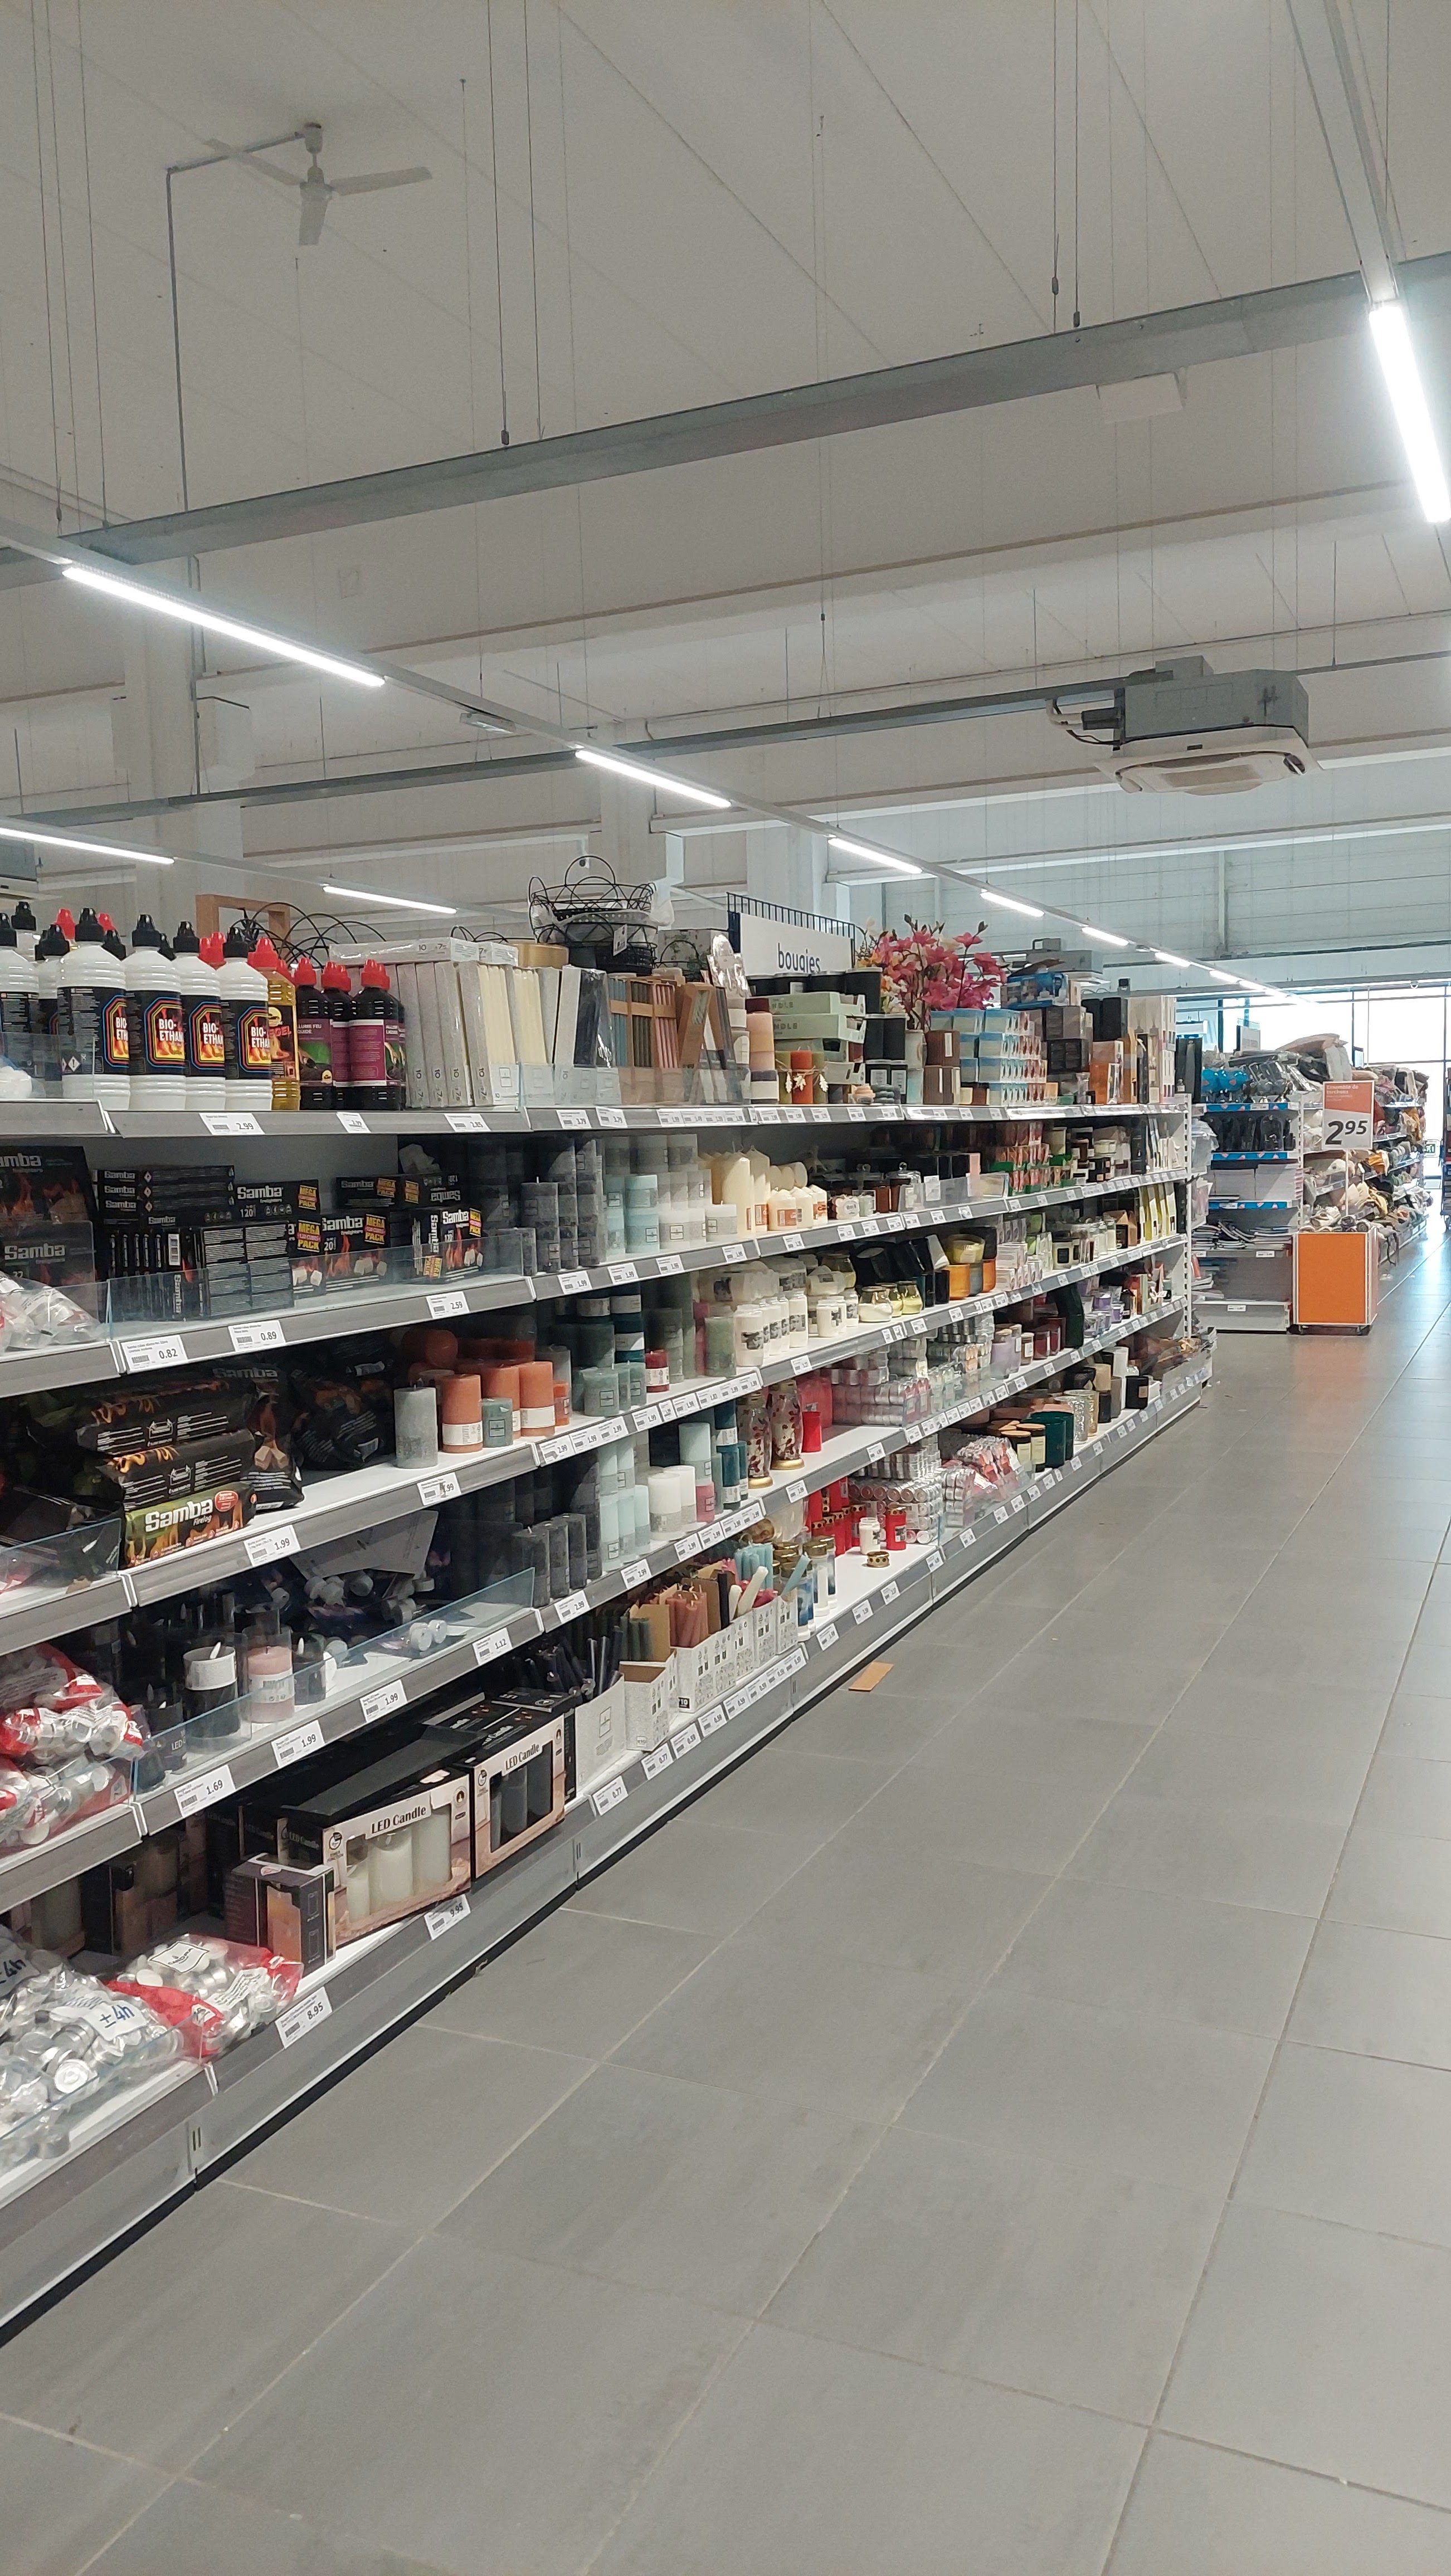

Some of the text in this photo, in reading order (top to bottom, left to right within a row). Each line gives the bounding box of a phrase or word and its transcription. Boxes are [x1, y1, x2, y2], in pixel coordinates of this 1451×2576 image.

[778, 943, 821, 973] bougies
[159, 1018, 177, 1030] BIO-
[203, 1023, 219, 1034] BIO-
[251, 1027, 266, 1037] BIO-
[105, 1171, 135, 1179] Samba
[104, 1185, 135, 1194] Samba
[341, 1180, 374, 1188] Samba
[237, 1185, 283, 1199] Samba
[300, 1187, 317, 1196] MEGA
[430, 1190, 461, 1203] Samba
[106, 1201, 137, 1209] Samba
[148, 1216, 176, 1225] Samba
[366, 1216, 385, 1228] MEGA
[442, 1209, 469, 1224] Samba
[298, 1222, 320, 1235] MEGA
[431, 1214, 439, 1253] Samba
[364, 1232, 384, 1242] PACK
[298, 1240, 319, 1250] PACK
[4, 1243, 65, 1260] Samba
[450, 1301, 462, 1309] 2.59
[260, 1331, 277, 1340] 0.89
[158, 1348, 178, 1359] 0.82
[212, 1367, 278, 1379] Samba
[145, 1499, 213, 1532] Samba
[193, 1515, 212, 1526] Firelog
[274, 1538, 290, 1550] 1.99
[574, 1600, 585, 1611] 2.99
[495, 1638, 507, 1650] 1.12
[384, 1692, 398, 1705] 1.99
[171, 1739, 183, 1750] LED
[301, 1734, 316, 1748] 1.99
[505, 1743, 540, 1770] LED Candle
[659, 1753, 668, 1764] 0.77
[206, 1779, 223, 1795] 1.69
[612, 1787, 622, 1799] 0.77
[371, 1806, 427, 1834] LED Candle
[450, 1902, 463, 1917] 9.95
[307, 2002, 324, 2020] 8.95
